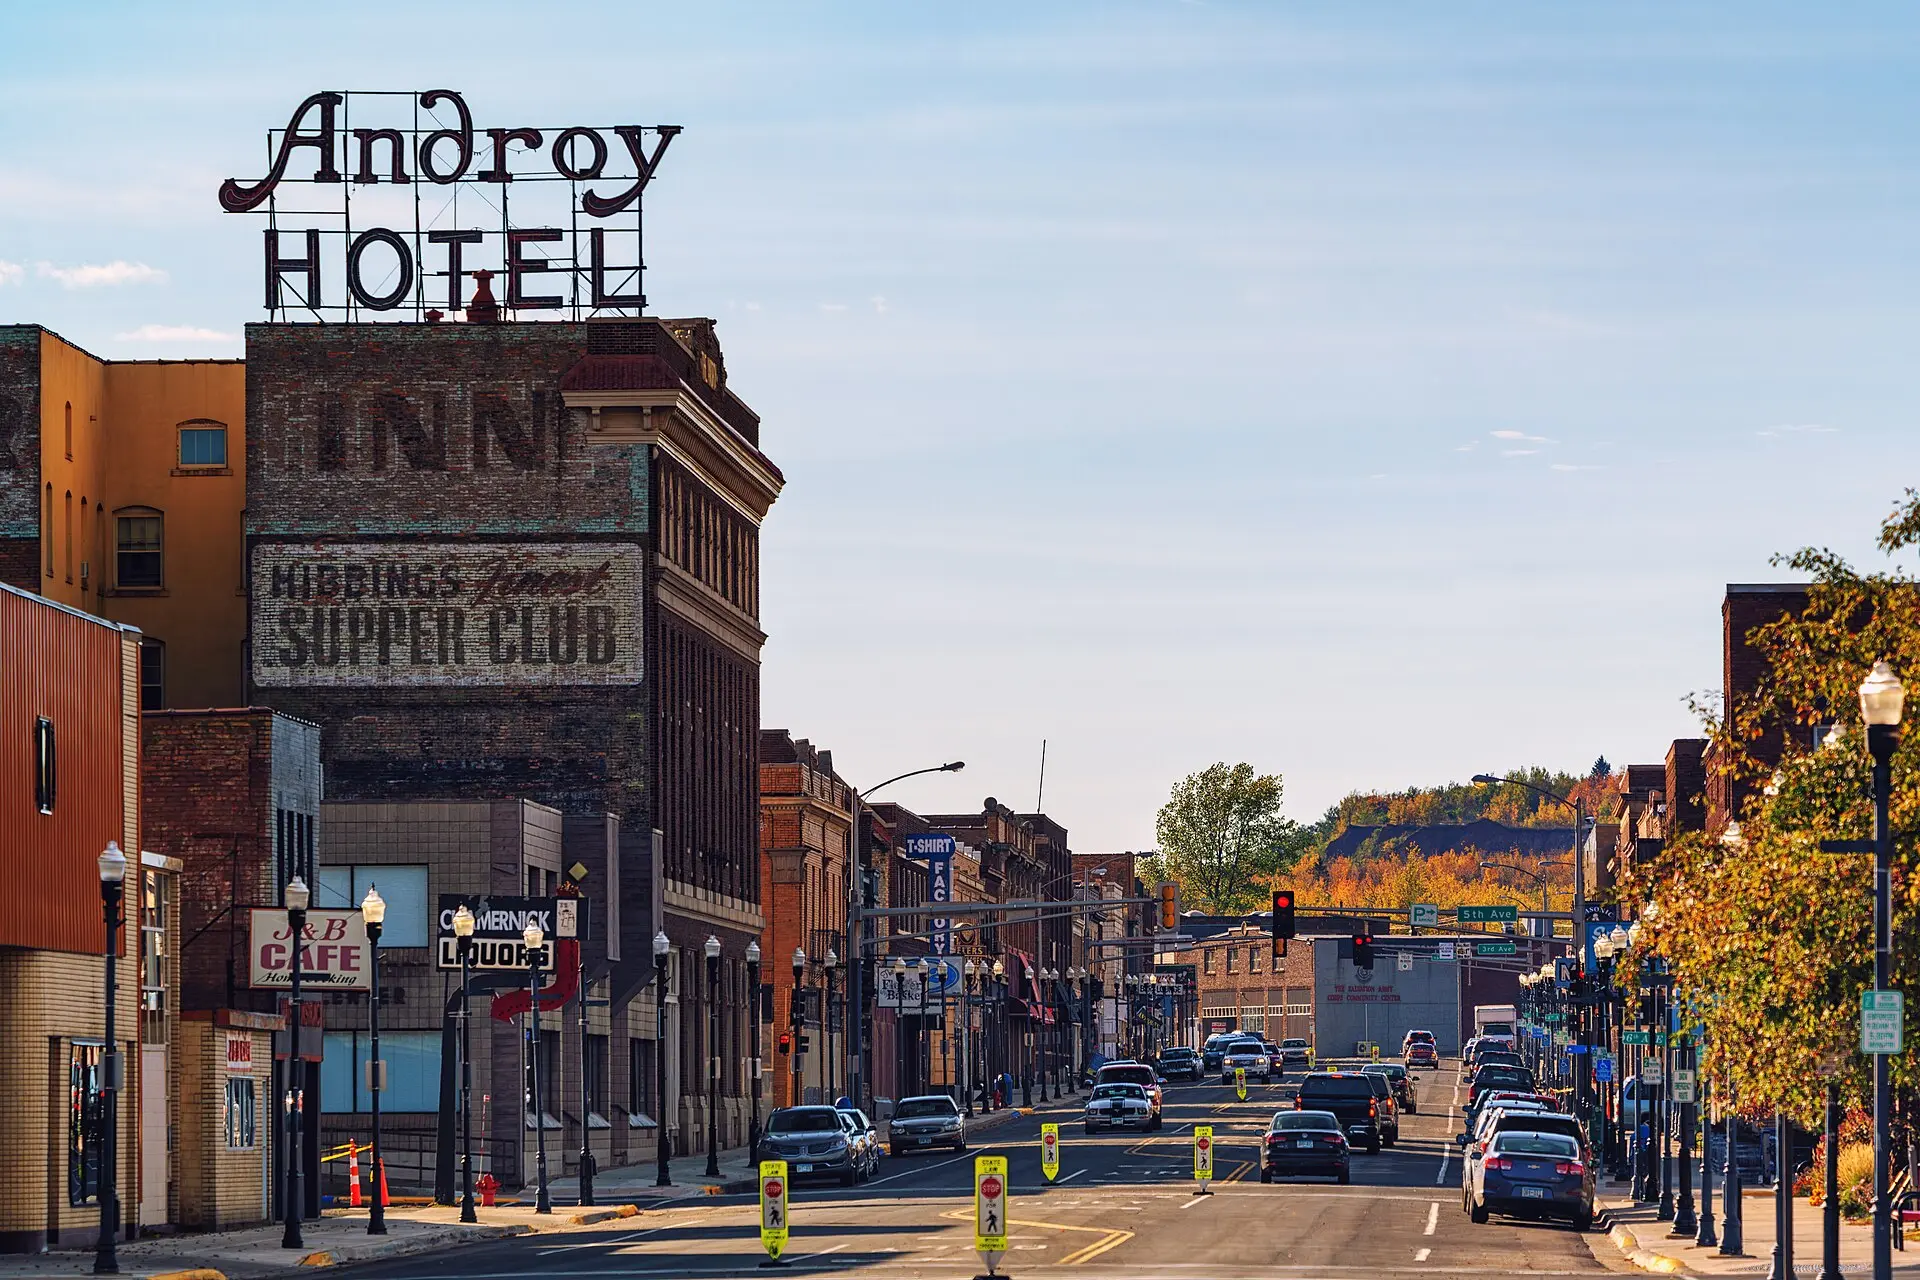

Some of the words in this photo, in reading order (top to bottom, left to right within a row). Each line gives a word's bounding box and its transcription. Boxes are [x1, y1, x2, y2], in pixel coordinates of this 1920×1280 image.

[219, 89, 683, 217] Androy
[264, 227, 647, 311] HOTEL
[271, 563, 463, 600] HIBBINGS
[279, 604, 466, 667] SUPPER
[487, 603, 616, 666] CLUB
[907, 838, 951, 854] T-SHIRT
[439, 909, 551, 932] CMERNICK
[933, 861, 946, 955] FACORY
[1463, 910, 1484, 919] 5th
[1490, 910, 1511, 919] Ave
[1584, 906, 1614, 918] ASONIC
[259, 943, 361, 972] CAFE
[766, 1185, 782, 1193] STOP
[982, 1184, 1000, 1193] STOP
